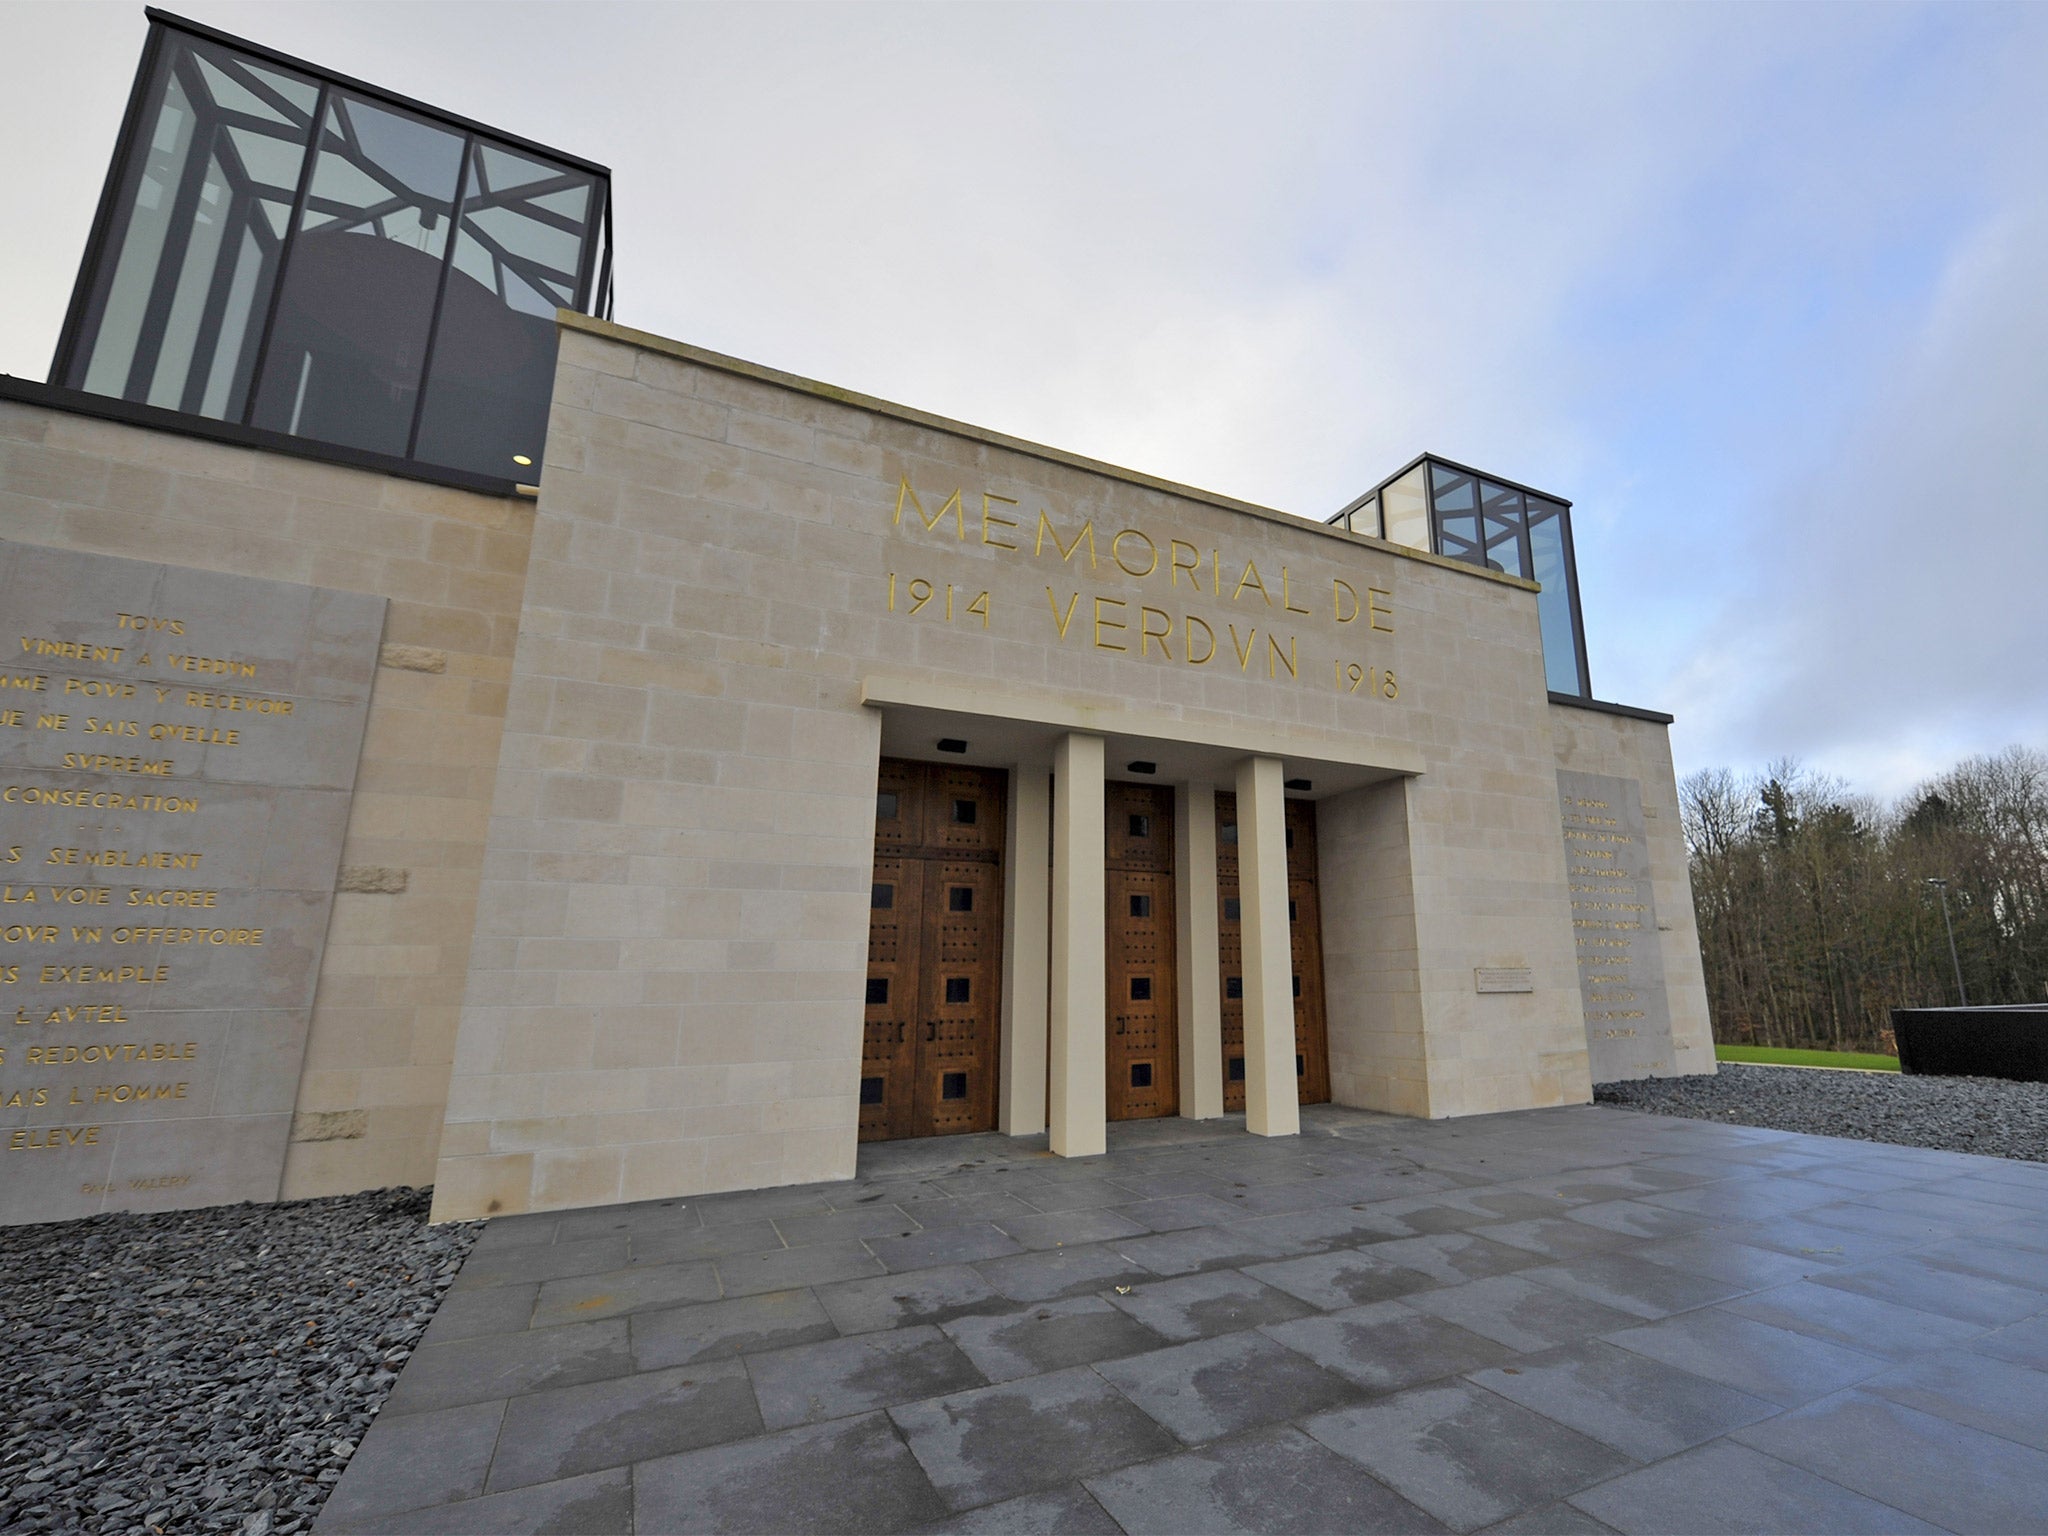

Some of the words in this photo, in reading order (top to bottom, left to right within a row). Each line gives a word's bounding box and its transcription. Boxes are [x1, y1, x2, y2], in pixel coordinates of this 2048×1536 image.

[893, 472, 1311, 615] MEMORIAL
[1333, 579, 1394, 634] DE
[116, 612, 186, 636] TOVS
[888, 573, 989, 627] 1914
[1045, 585, 1298, 678] VERDVN
[1335, 661, 1400, 700] 1918
[167, 653, 257, 679] VERDVN
[63, 678, 138, 700] POVR
[156, 687, 170, 705] Y
[185, 690, 295, 717] RECEVOIR
[36, 713, 69, 731] NE
[83, 717, 140, 737] SAIS
[147, 723, 239, 747] QVELLE
[46, 847, 203, 871] SEMBLAIENT
[3, 885, 39, 904] LA
[51, 886, 111, 906] VOIE
[0, 924, 61, 944] OVR
[71, 926, 103, 944] VN
[111, 926, 264, 947] OFFERTOIRE
[39, 965, 170, 985] EXEMPLE
[25, 1042, 198, 1066] REDOVTABLE
[0, 1088, 49, 1108] AIS
